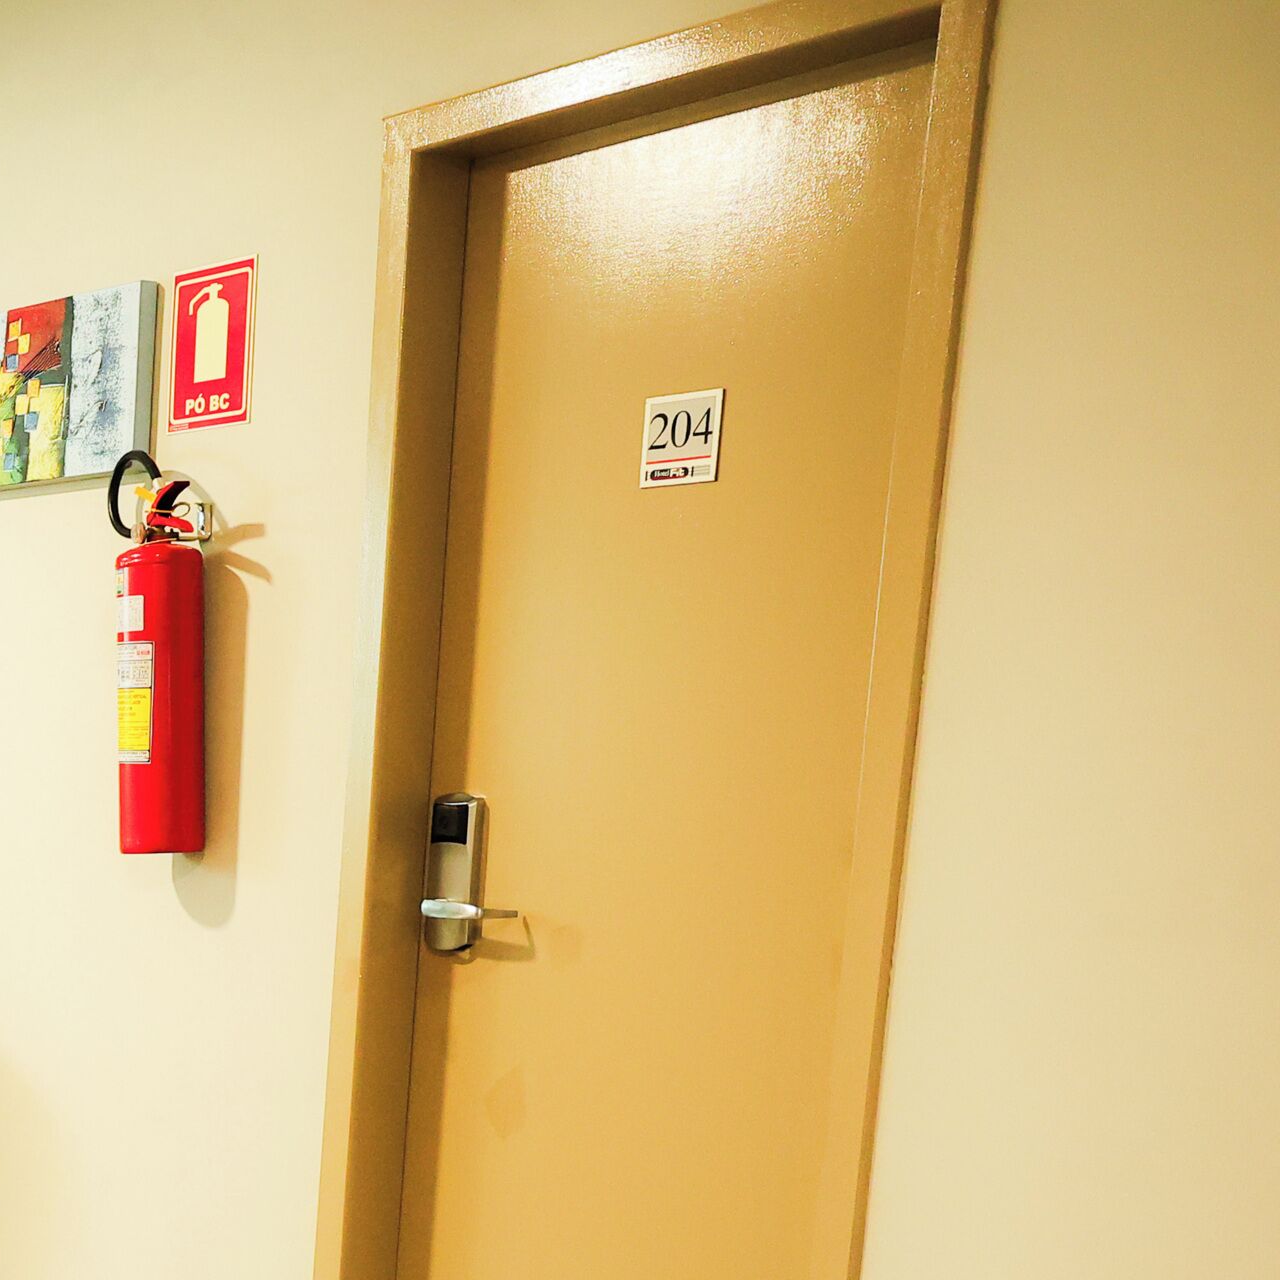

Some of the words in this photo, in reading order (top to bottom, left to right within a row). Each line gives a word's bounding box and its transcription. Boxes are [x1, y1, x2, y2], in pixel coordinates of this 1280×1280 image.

[185, 393, 205, 416] PÓ
[209, 393, 230, 412] BC
[648, 407, 713, 450] 204
